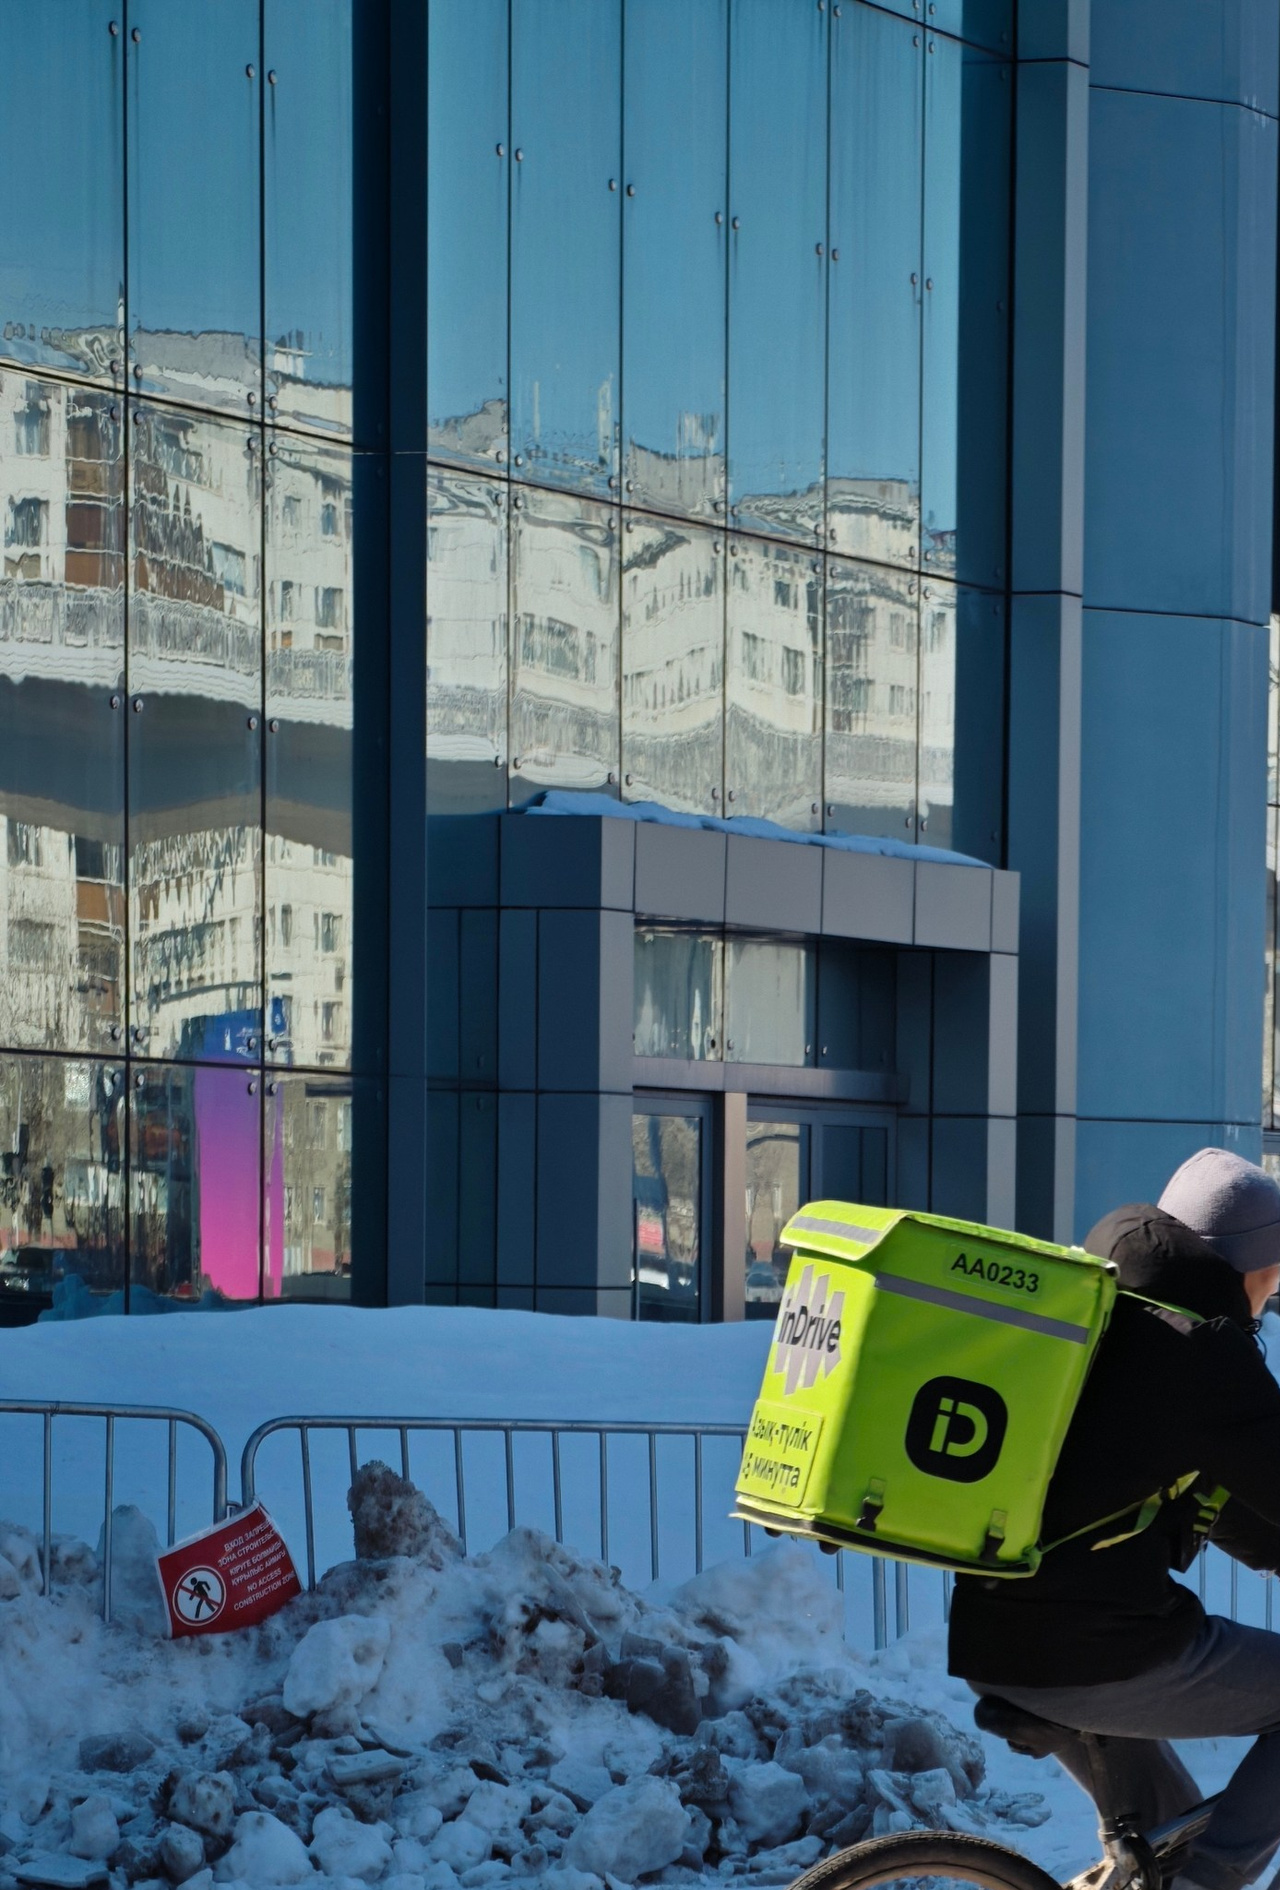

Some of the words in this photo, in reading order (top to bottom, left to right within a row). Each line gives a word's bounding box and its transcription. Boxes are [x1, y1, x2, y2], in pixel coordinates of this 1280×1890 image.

[950, 1252, 1040, 1293] AA0233
[777, 1298, 842, 1354] inDrive
[223, 1536, 245, 1553] ВХОД
[246, 1583, 258, 1592] NO
[258, 1568, 282, 1587] ACCESS
